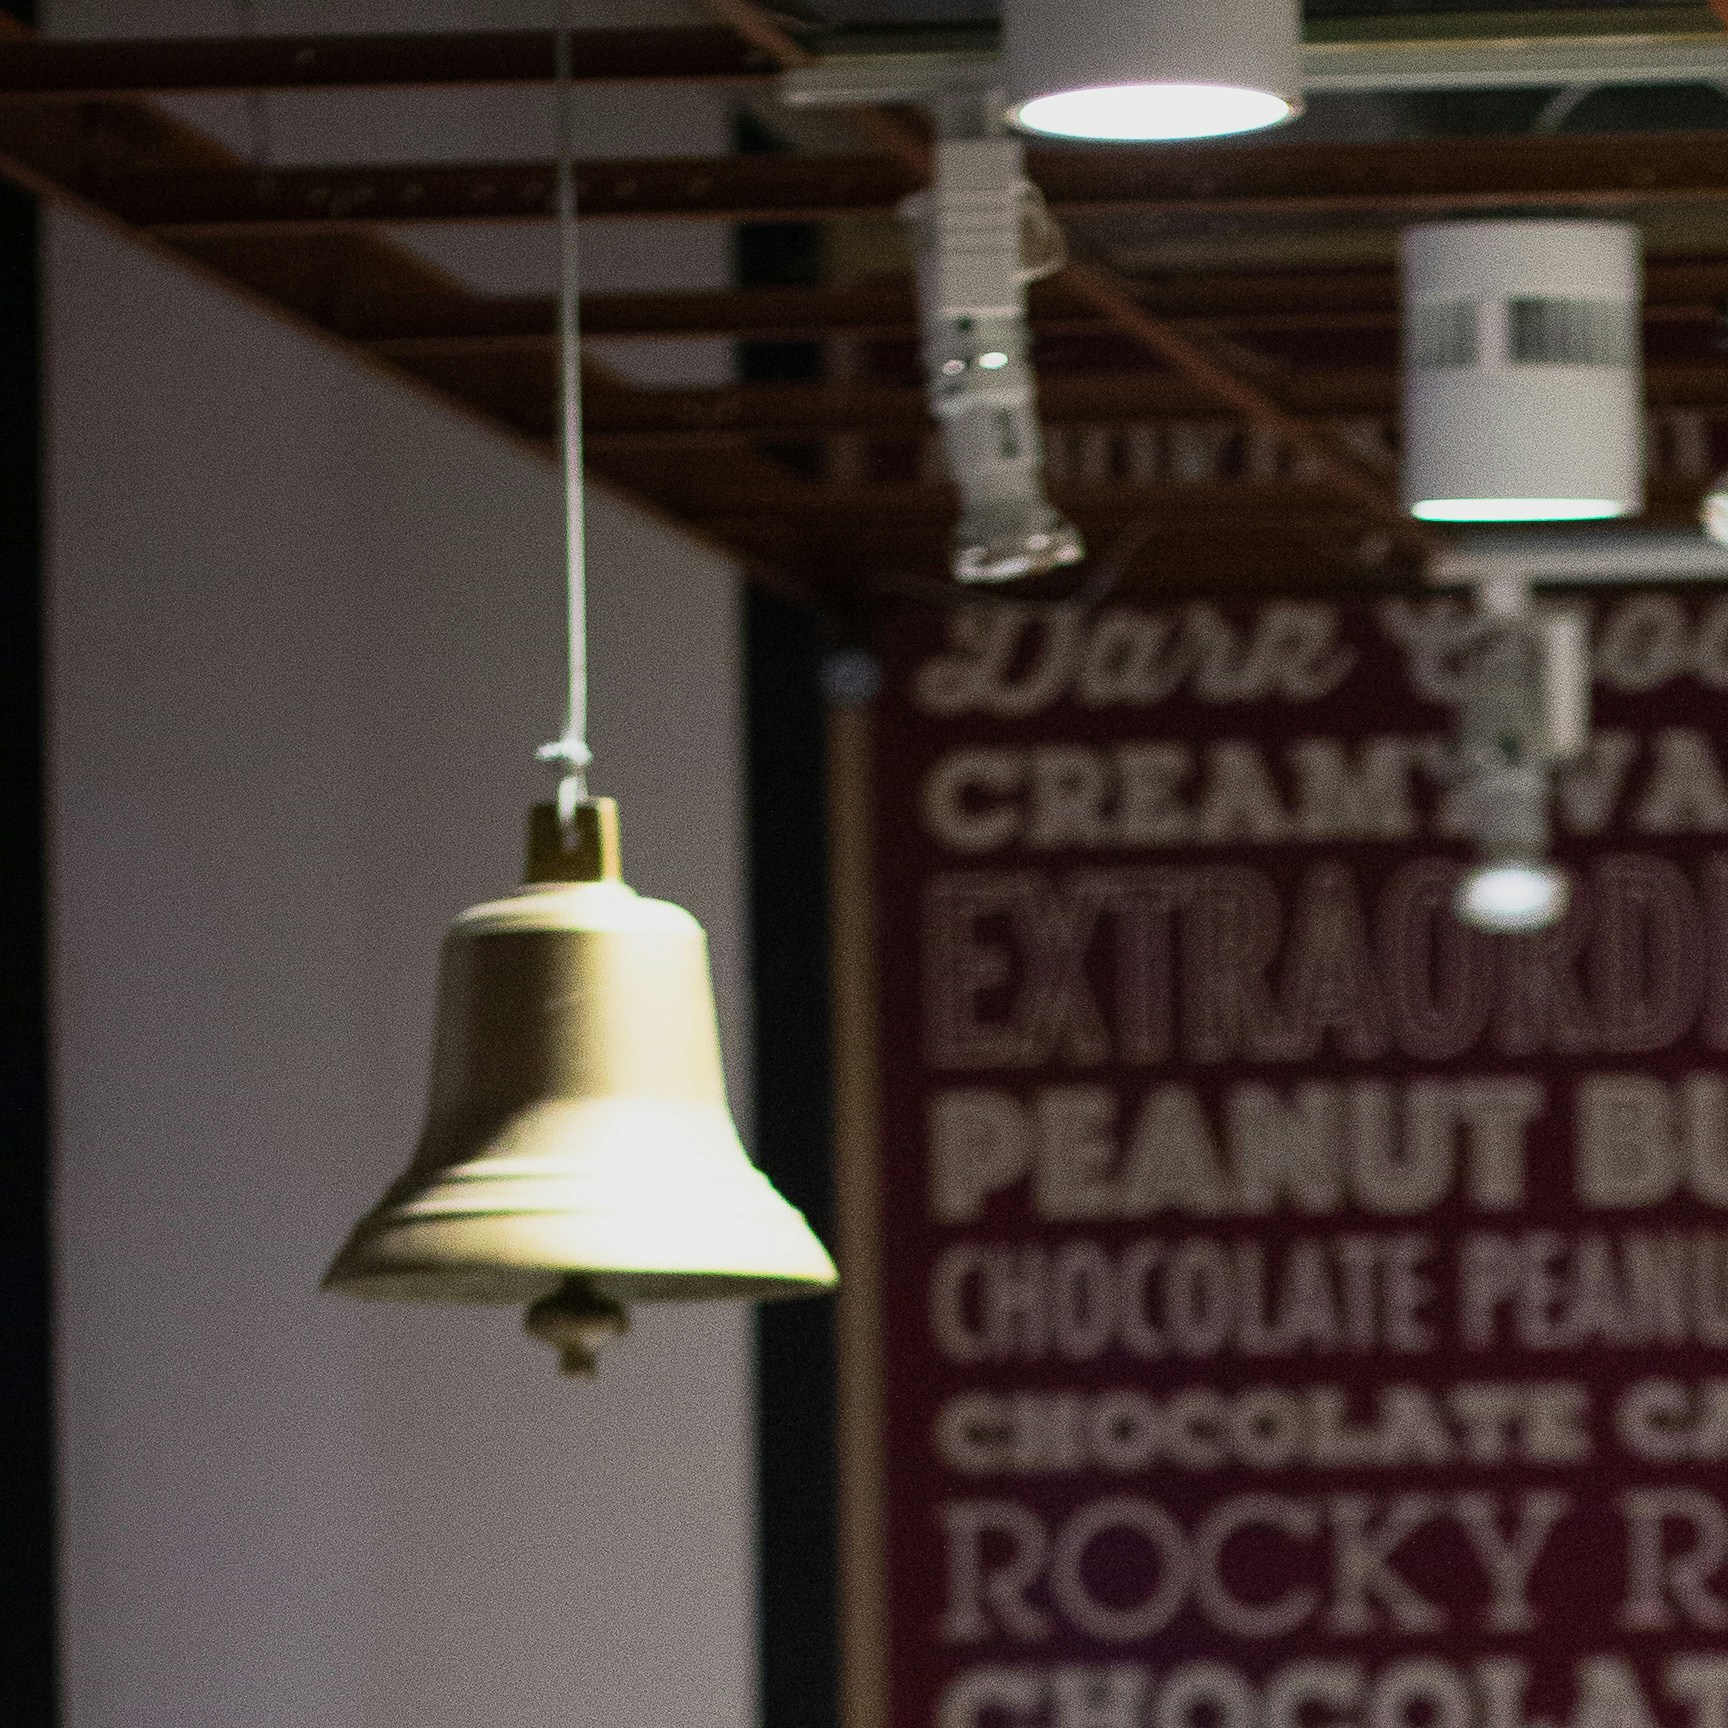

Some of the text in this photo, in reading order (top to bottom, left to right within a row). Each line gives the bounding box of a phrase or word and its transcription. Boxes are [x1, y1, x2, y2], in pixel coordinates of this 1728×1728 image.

[931, 1075, 1543, 1221] PEANUT
[930, 1232, 1434, 1360] CHOCOLATE
[936, 1381, 1592, 1474] CHOCOLATE
[938, 1486, 1574, 1642] ROCKY
